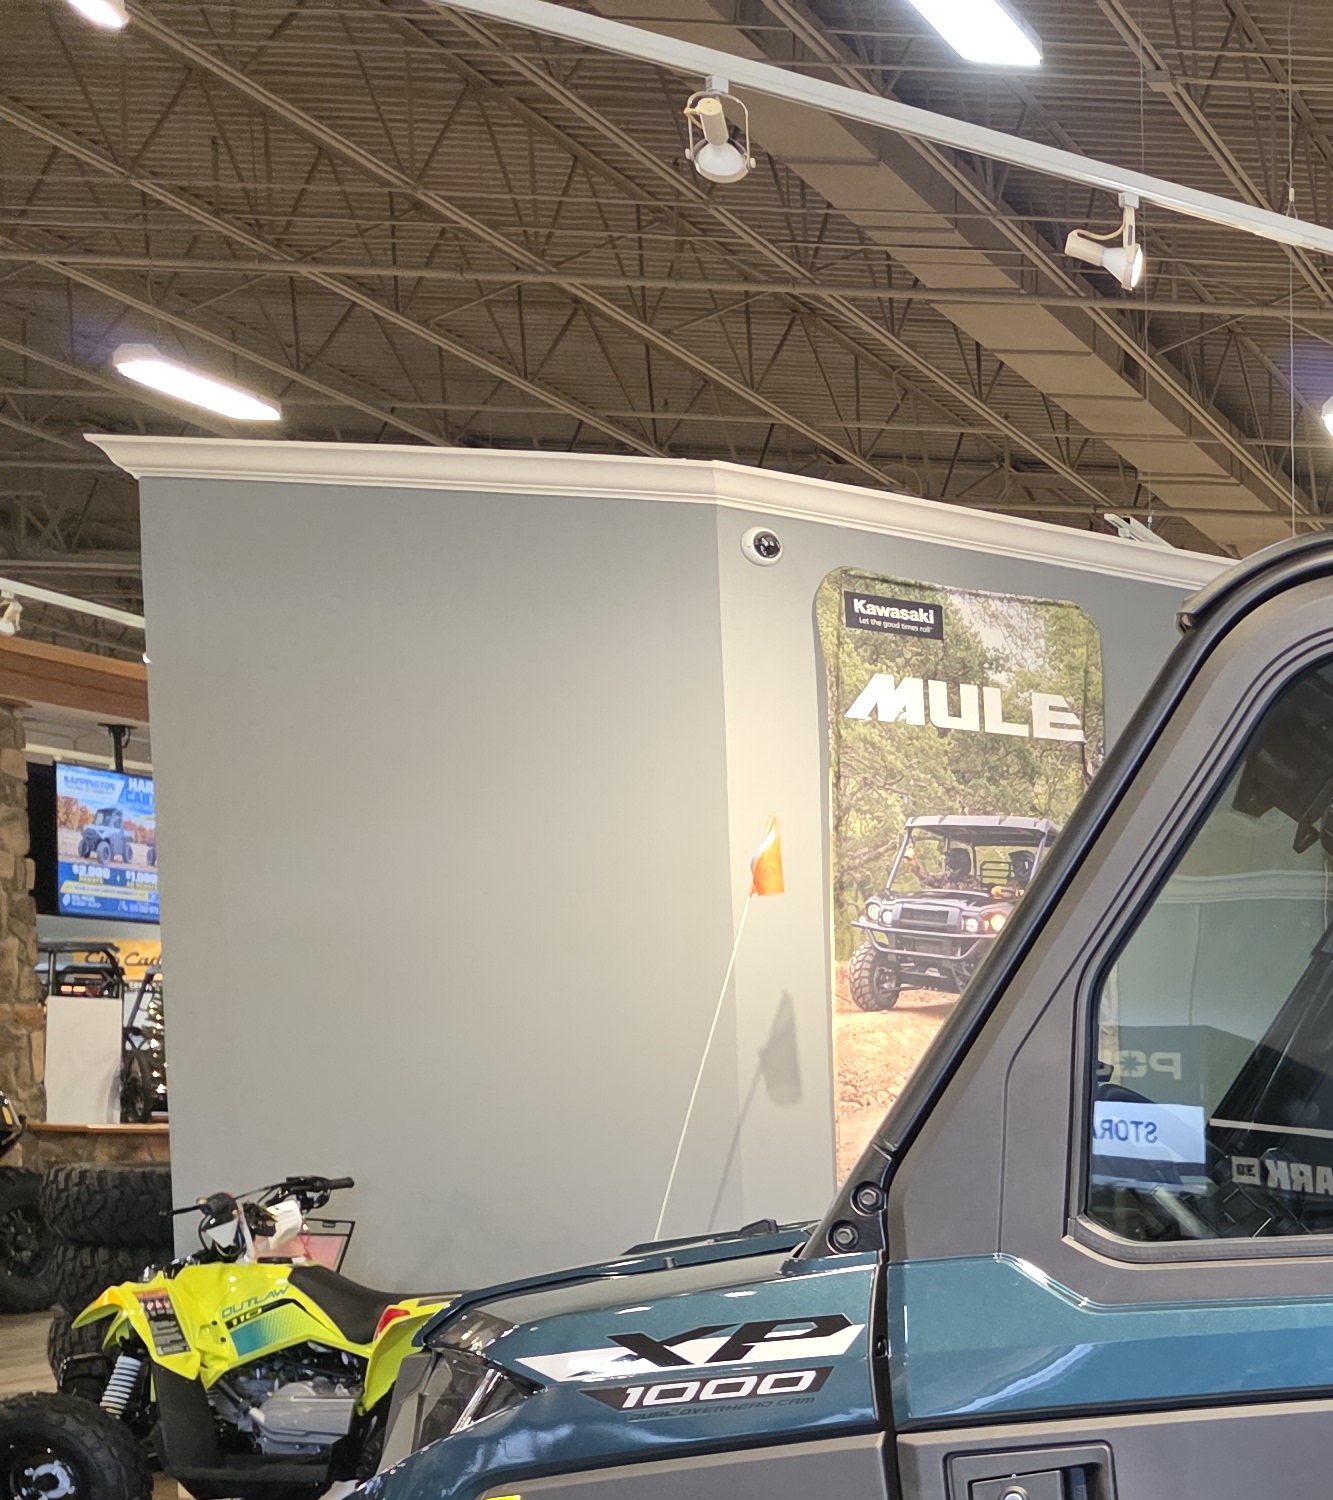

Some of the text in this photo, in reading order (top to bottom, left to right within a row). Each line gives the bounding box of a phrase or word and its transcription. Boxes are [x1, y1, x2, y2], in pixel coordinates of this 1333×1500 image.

[853, 598, 935, 624] Kawasaki
[859, 617, 869, 625] Let
[870, 618, 882, 627] the
[883, 620, 900, 629] good
[901, 623, 919, 632] times
[844, 673, 1086, 742] MULE
[222, 1285, 290, 1318] OUTLAW
[606, 1312, 856, 1368] XP
[622, 1370, 817, 1409] 1000
[629, 1396, 816, 1421] DUAL OVERHEAD CAM
